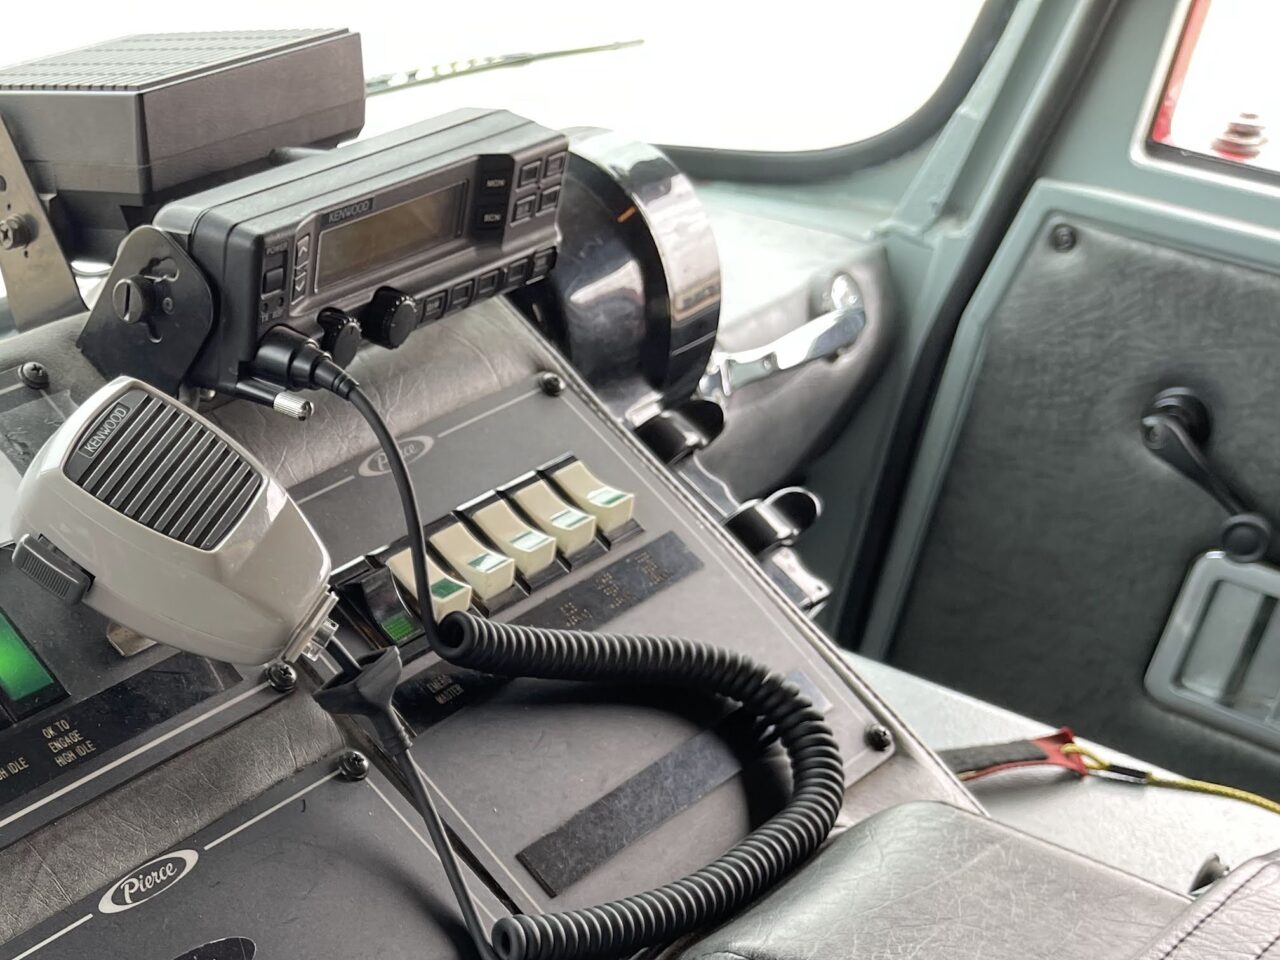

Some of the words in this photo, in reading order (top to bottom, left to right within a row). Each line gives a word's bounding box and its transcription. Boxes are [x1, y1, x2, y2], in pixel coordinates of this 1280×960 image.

[328, 201, 369, 223] KENWOOD
[83, 406, 128, 456] KENWOOD
[42, 727, 56, 739] OK
[56, 719, 70, 732] TO
[48, 730, 84, 753] ENGAGE
[54, 751, 77, 767] HIGH
[77, 740, 96, 757] IDLE
[8, 757, 29, 775] IDLE
[120, 861, 177, 904] Pierce
